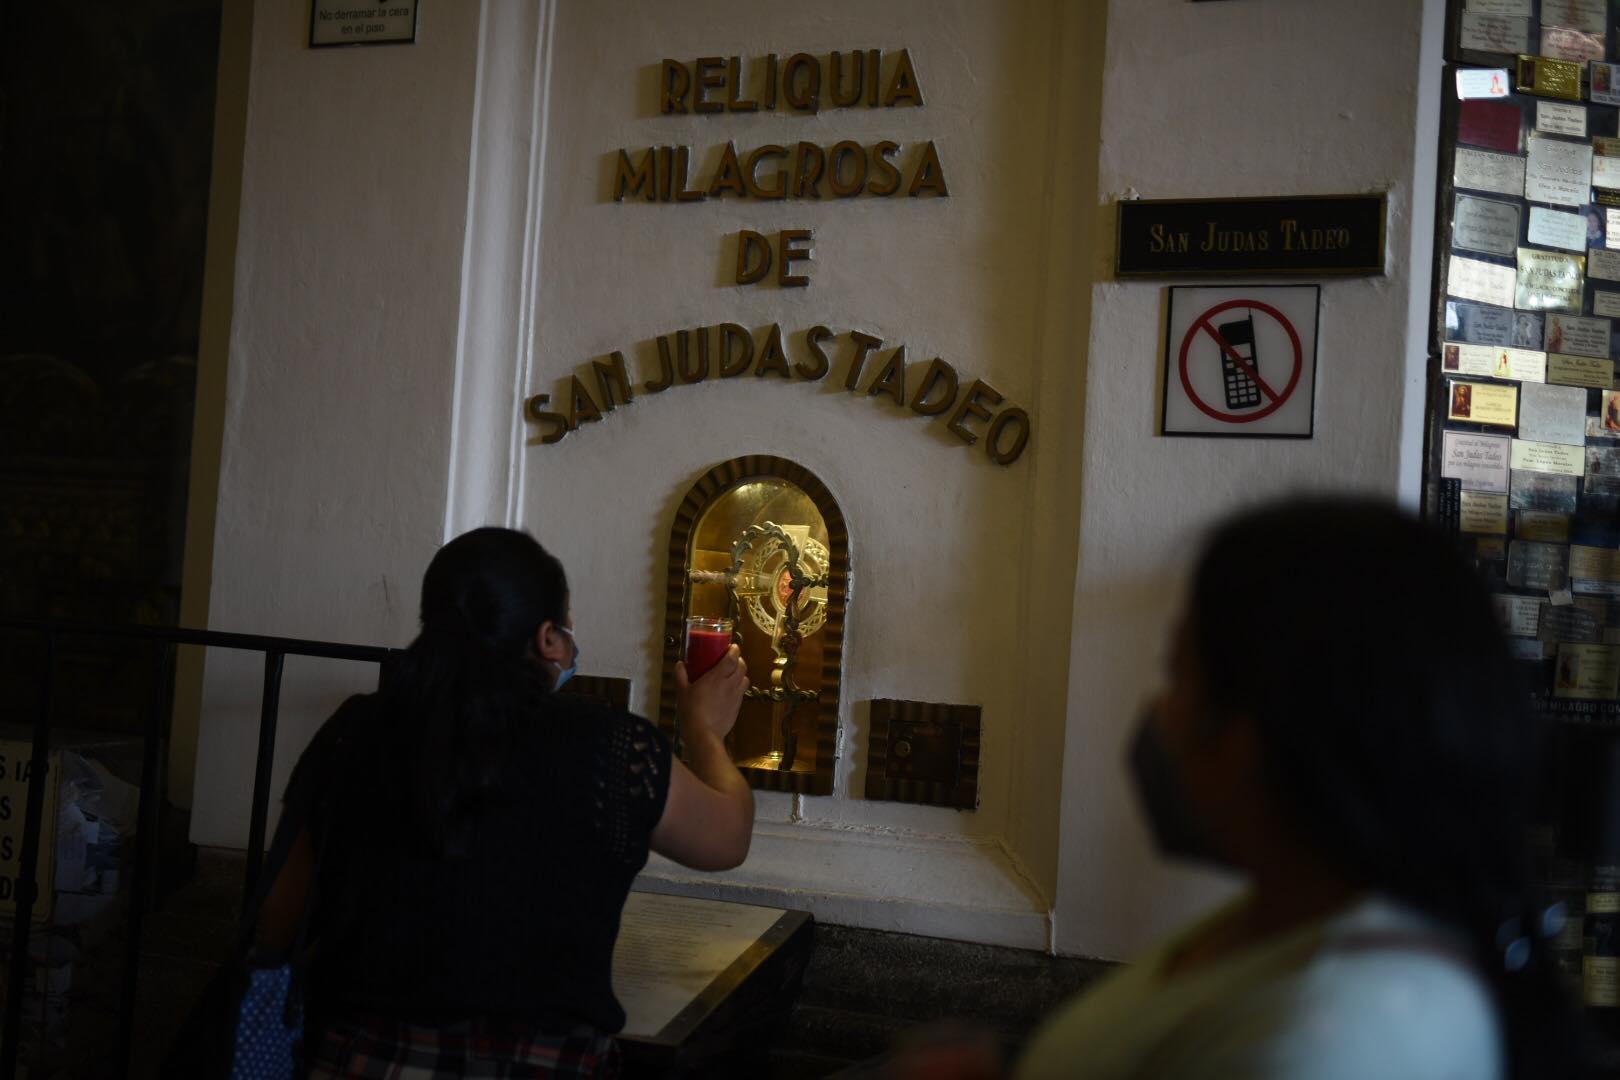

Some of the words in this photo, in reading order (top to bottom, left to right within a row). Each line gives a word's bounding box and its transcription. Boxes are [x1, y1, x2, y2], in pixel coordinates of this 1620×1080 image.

[320, 9, 333, 20] No
[335, 8, 377, 20] derramar
[378, 7, 387, 17] la
[388, 7, 409, 17] cera
[342, 25, 353, 34] en
[355, 24, 364, 33] el
[366, 24, 385, 35] piso
[660, 48, 925, 114] RELIQUIA
[613, 140, 949, 201] MILAGROSA
[735, 229, 812, 287] DE
[526, 351, 632, 444] SAN
[645, 322, 834, 393] JUDAS
[845, 329, 1031, 466] TADEO
